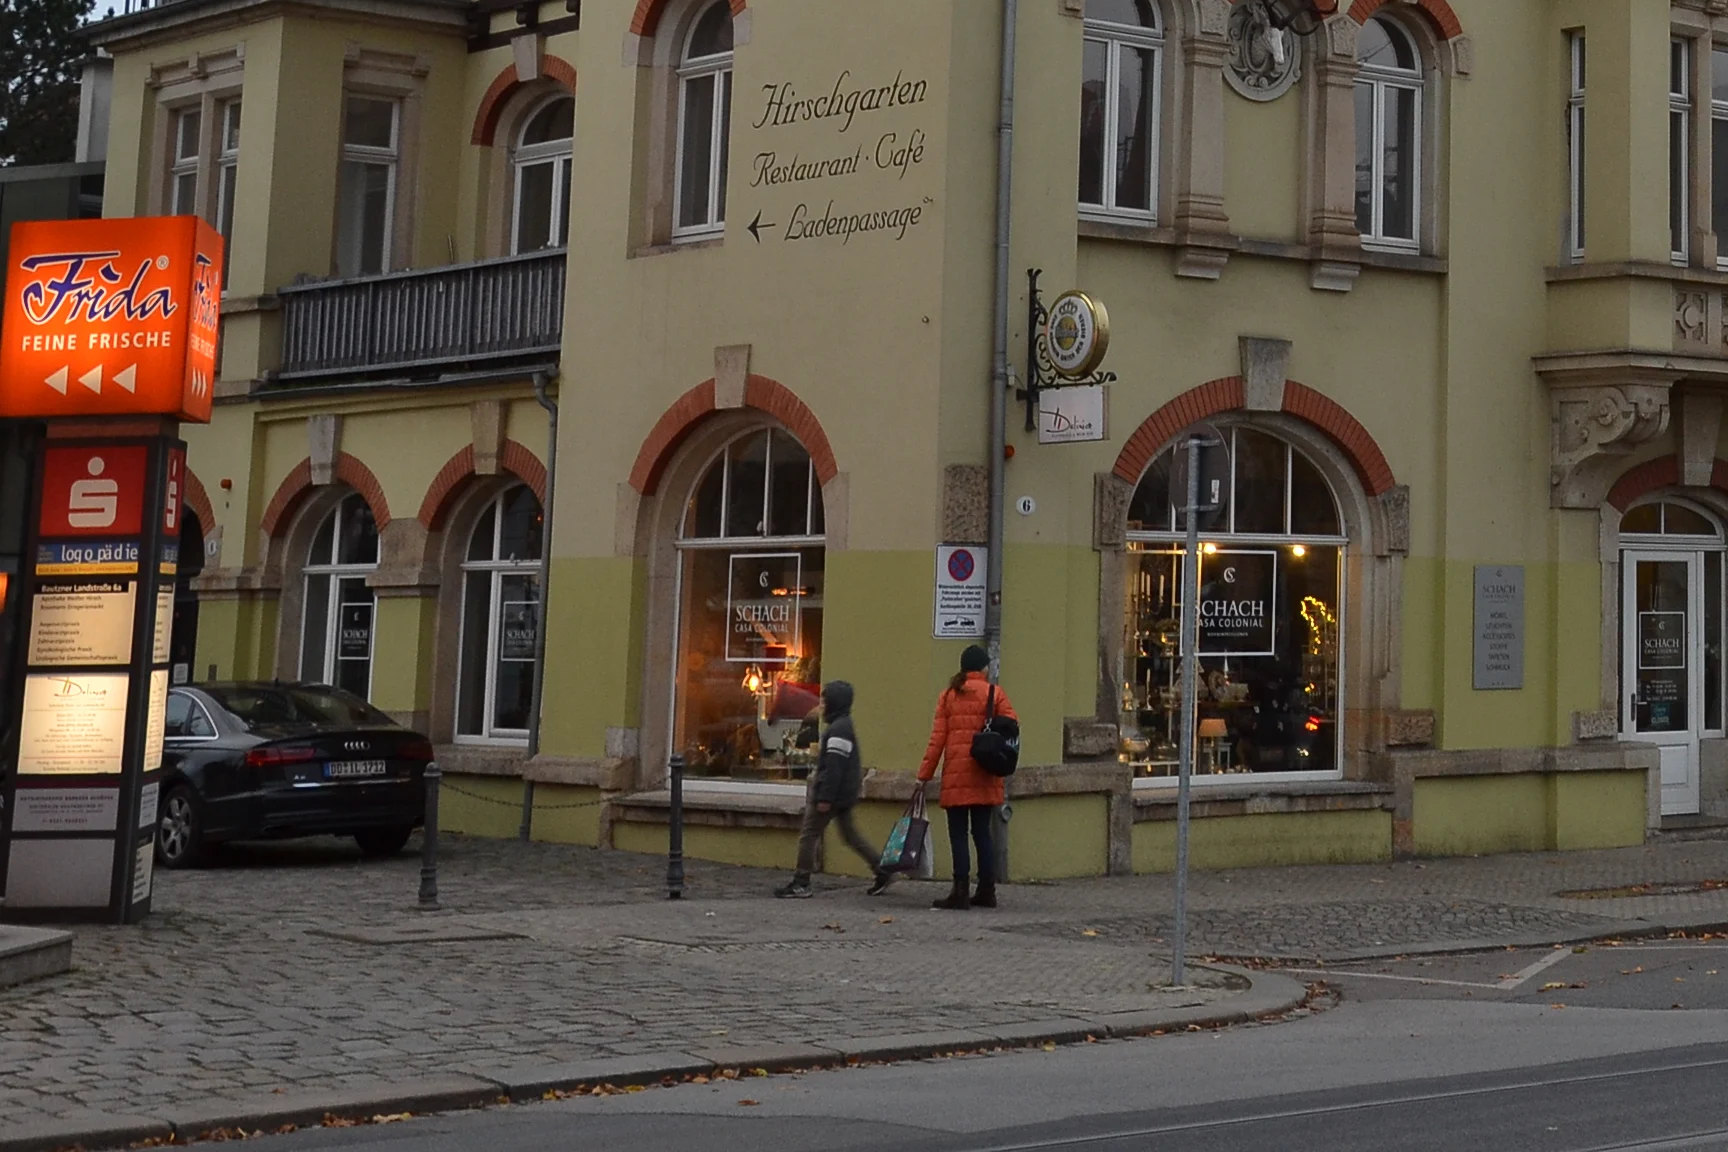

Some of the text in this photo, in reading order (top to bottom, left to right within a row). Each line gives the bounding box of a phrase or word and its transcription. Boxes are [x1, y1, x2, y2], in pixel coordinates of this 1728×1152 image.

[752, 69, 927, 133] Hirschgarten
[750, 128, 926, 188] Restaurant Café
[784, 199, 922, 246] Ladenpassage
[20, 250, 178, 325] Frida
[22, 334, 77, 352] FEINE
[89, 331, 171, 349] FRISCHE
[1022, 499, 1031, 512] 6
[736, 605, 789, 621] SCHACH
[735, 623, 789, 633] CASA COLONIAL
[1219, 619, 1263, 627] COLONIAL
[1644, 638, 1679, 648] SCHACH
